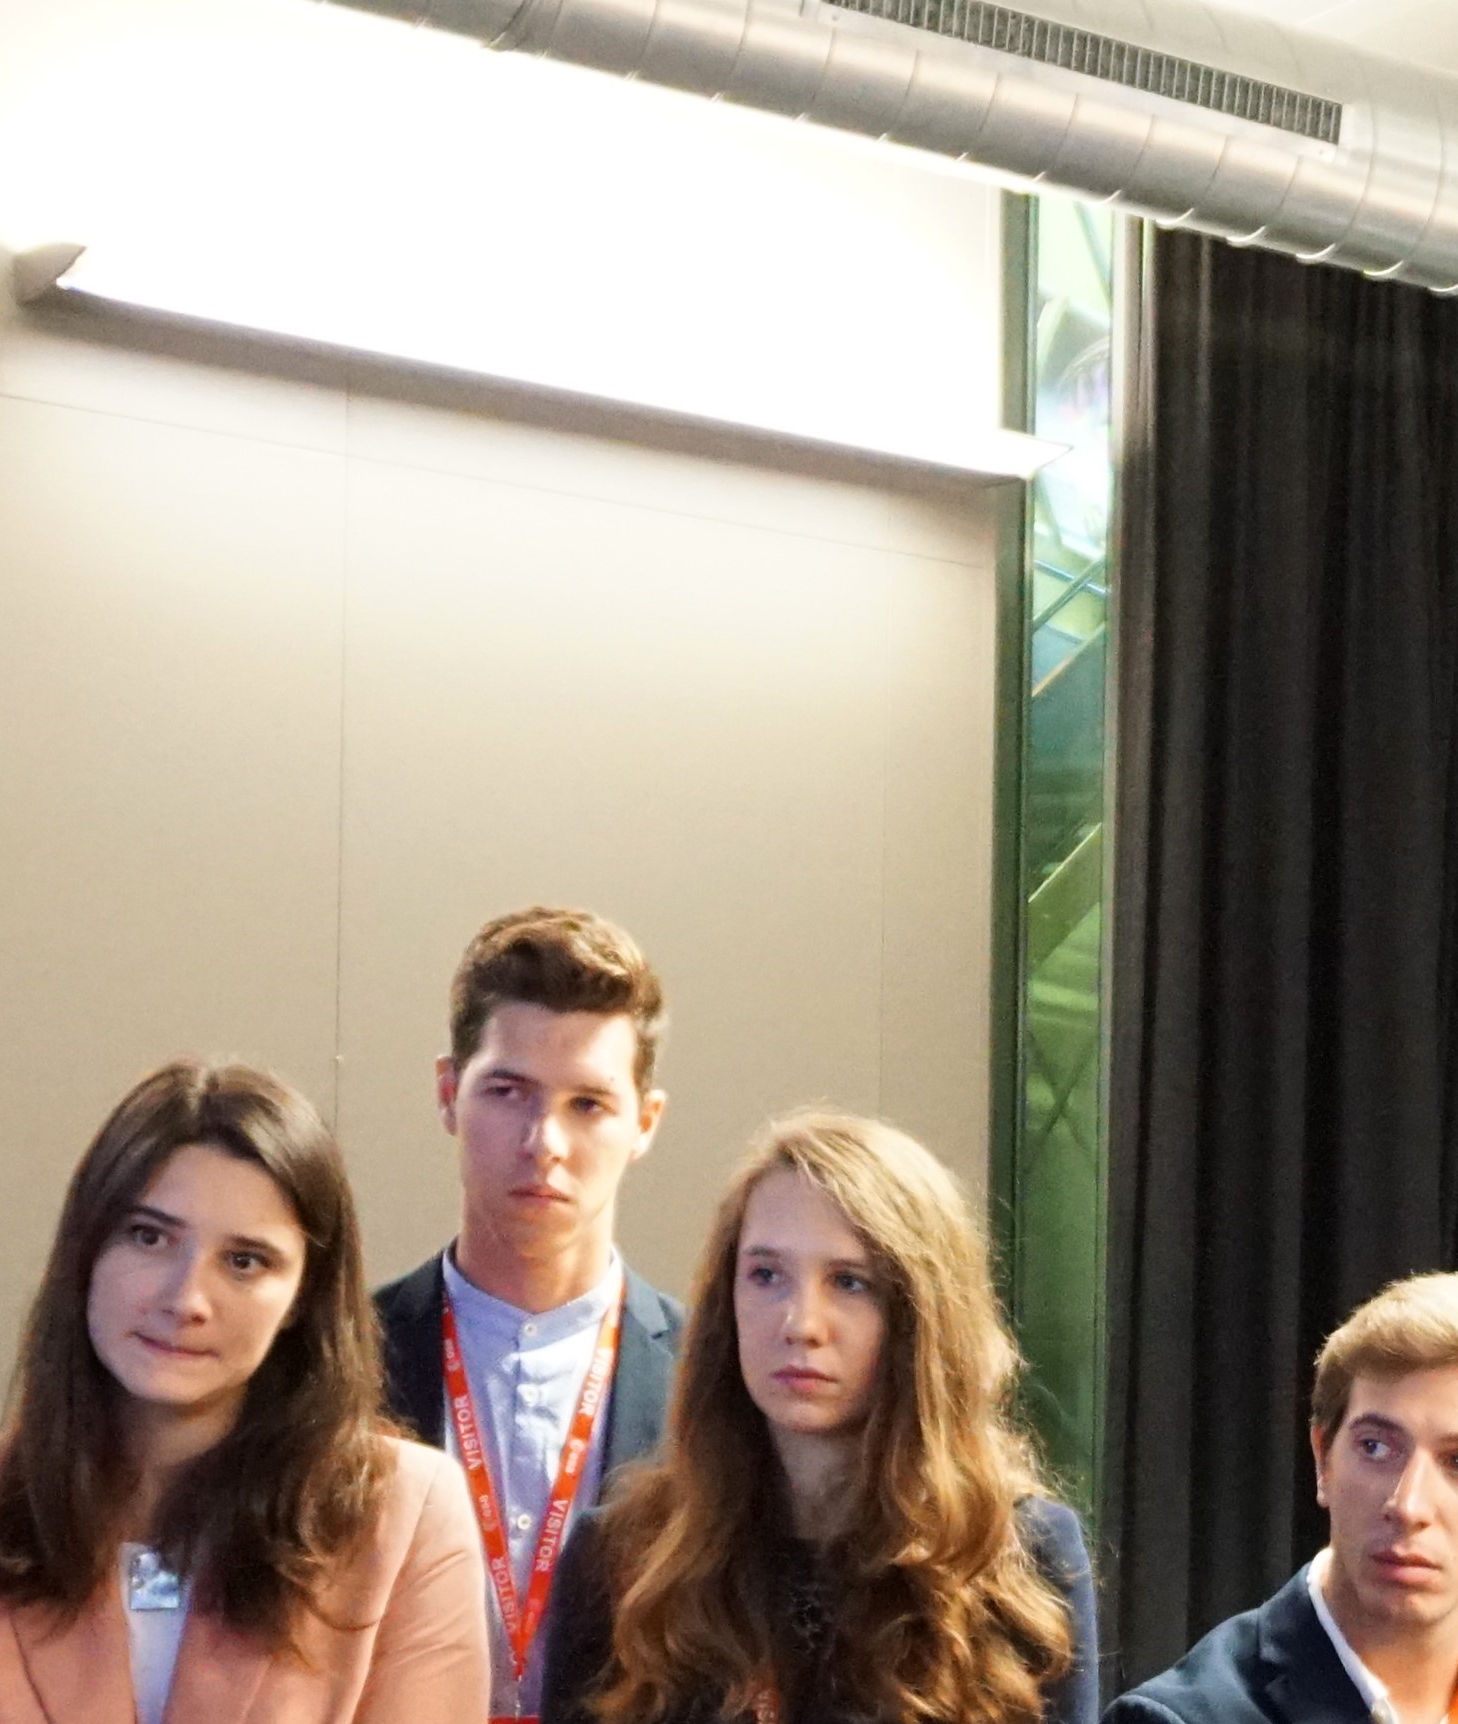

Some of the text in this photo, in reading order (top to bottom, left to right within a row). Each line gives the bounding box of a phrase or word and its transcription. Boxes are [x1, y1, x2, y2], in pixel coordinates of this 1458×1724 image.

[453, 1394, 483, 1470] VISITOR
[535, 1499, 569, 1572] VISITOR
[492, 1556, 518, 1634] VISITOR
